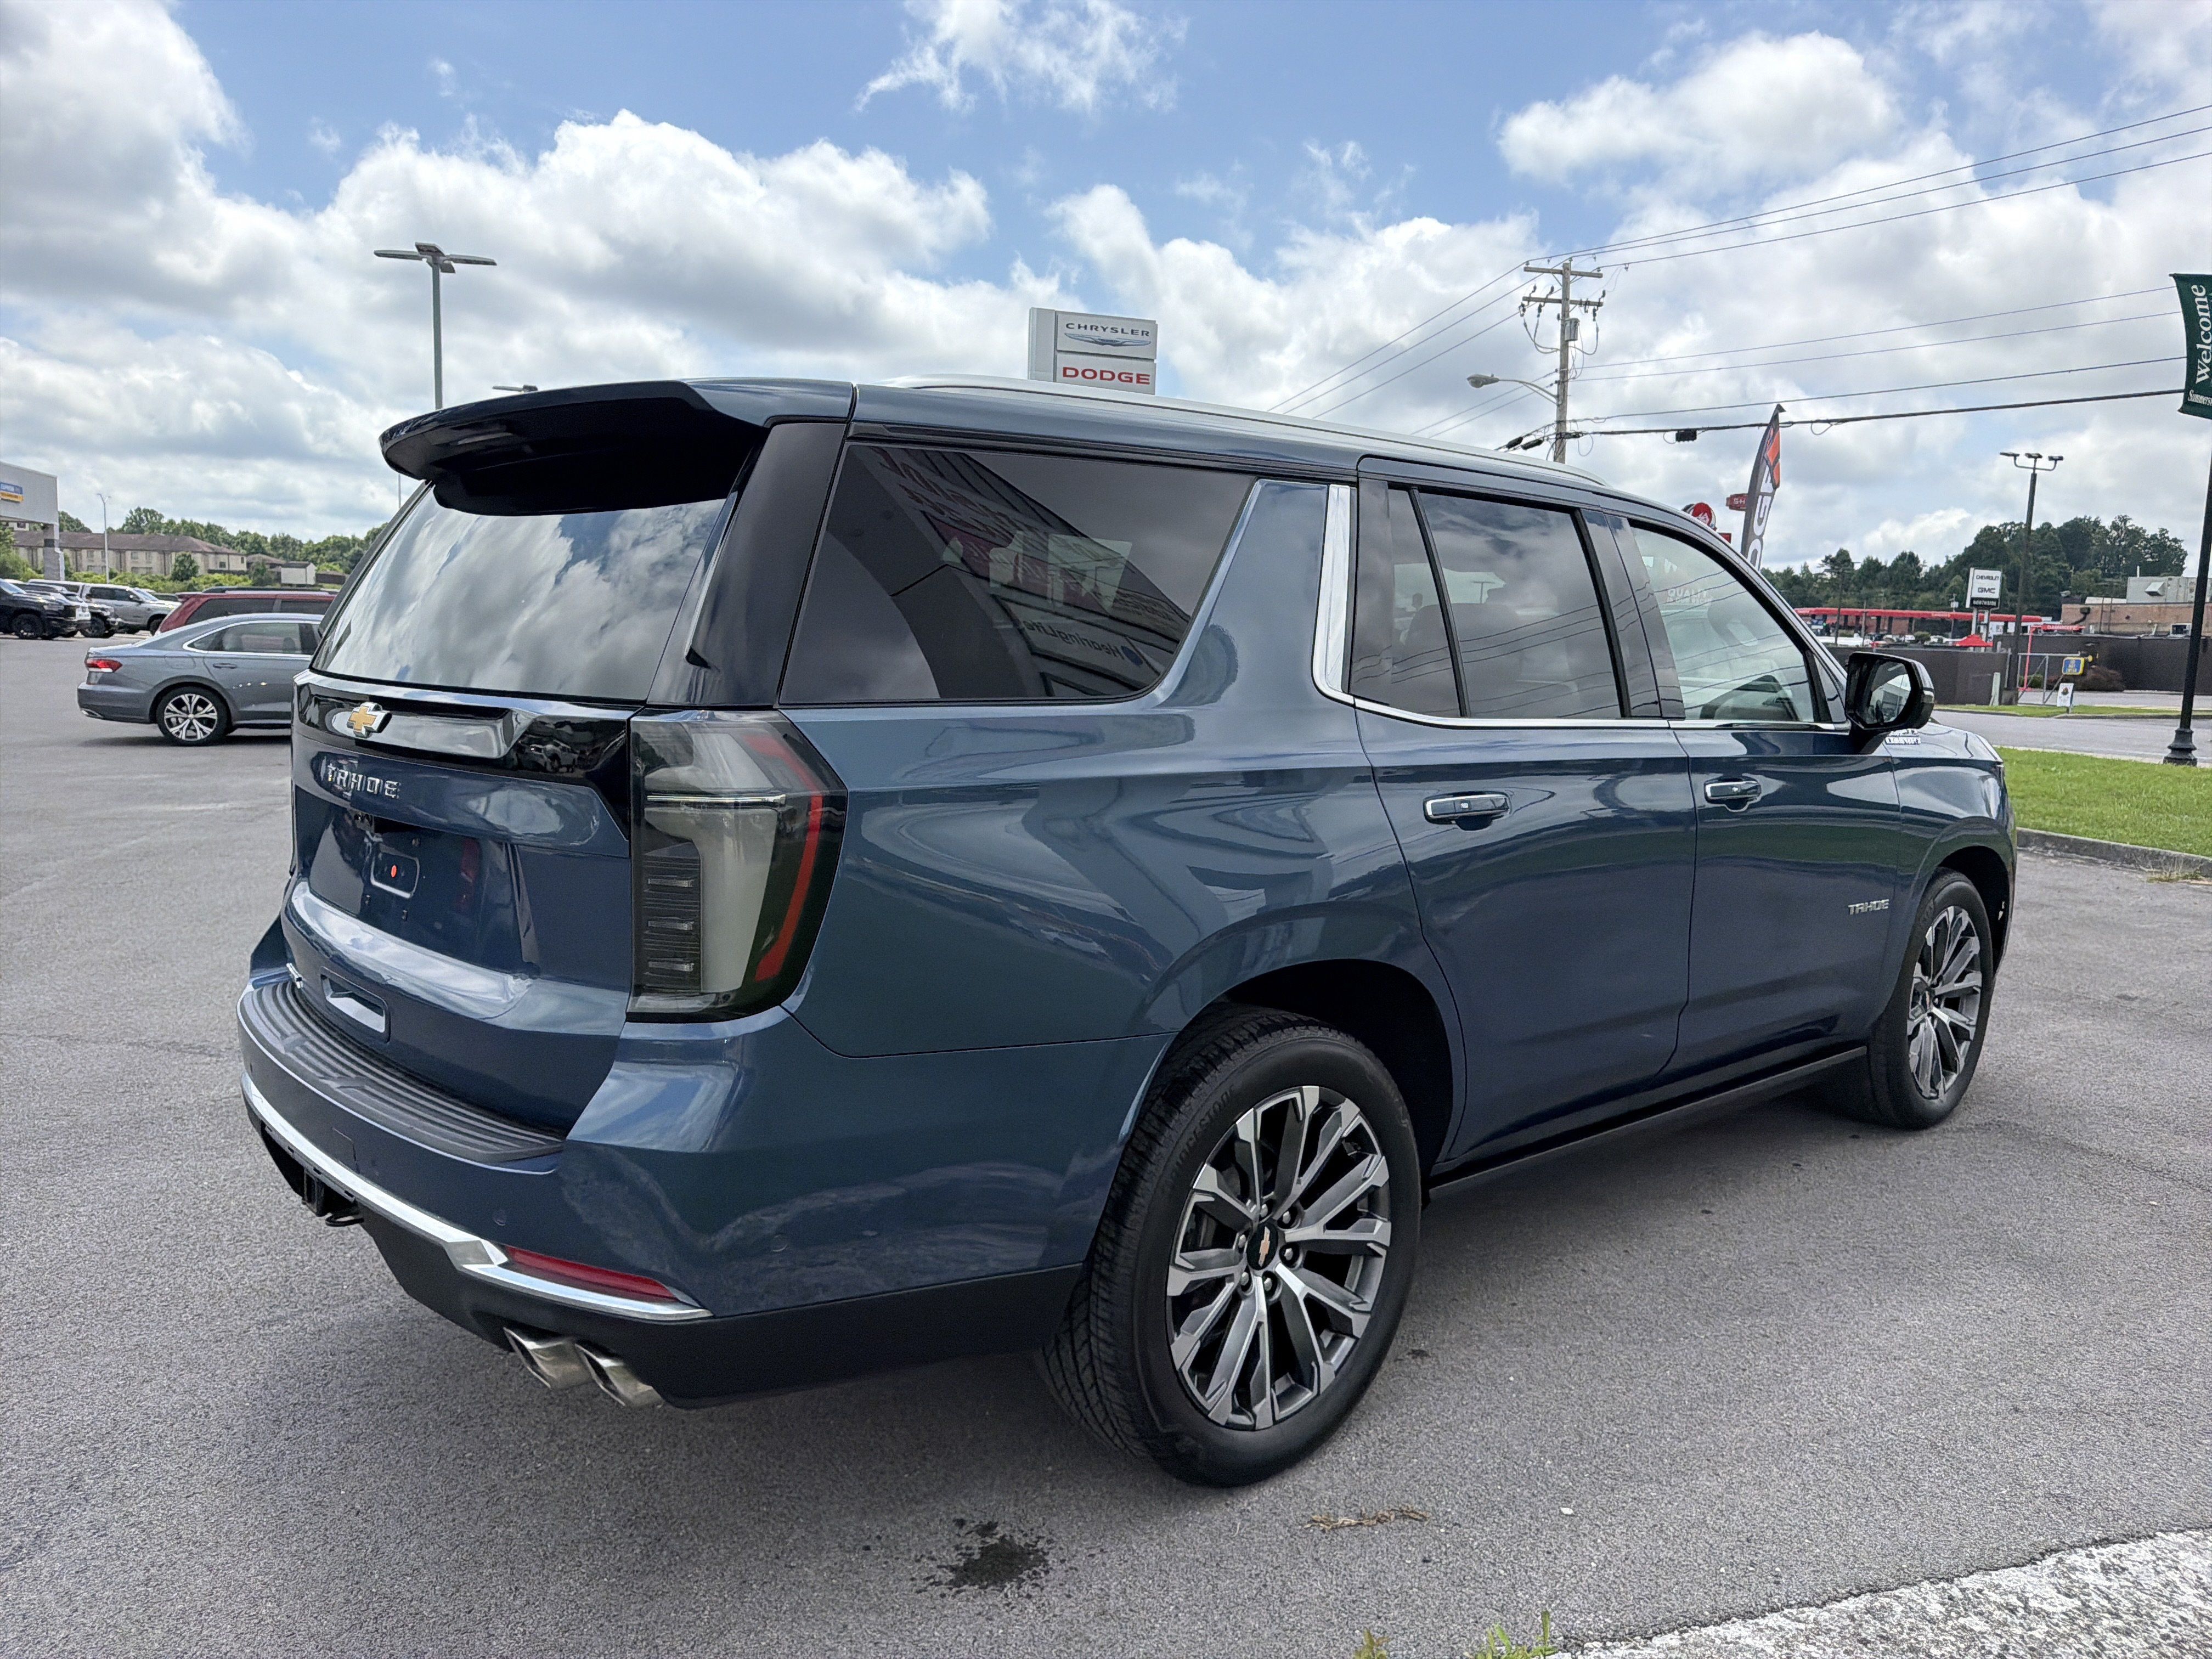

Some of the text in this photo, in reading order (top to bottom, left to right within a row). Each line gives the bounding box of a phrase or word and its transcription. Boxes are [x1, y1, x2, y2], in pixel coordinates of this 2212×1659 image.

[1065, 323, 1150, 337] CHRYSLER
[2191, 285, 2212, 384] Welcome
[1063, 366, 1150, 385] DODGE
[328, 763, 400, 799] TAHOE
[1848, 899, 1889, 915] TAHOE
